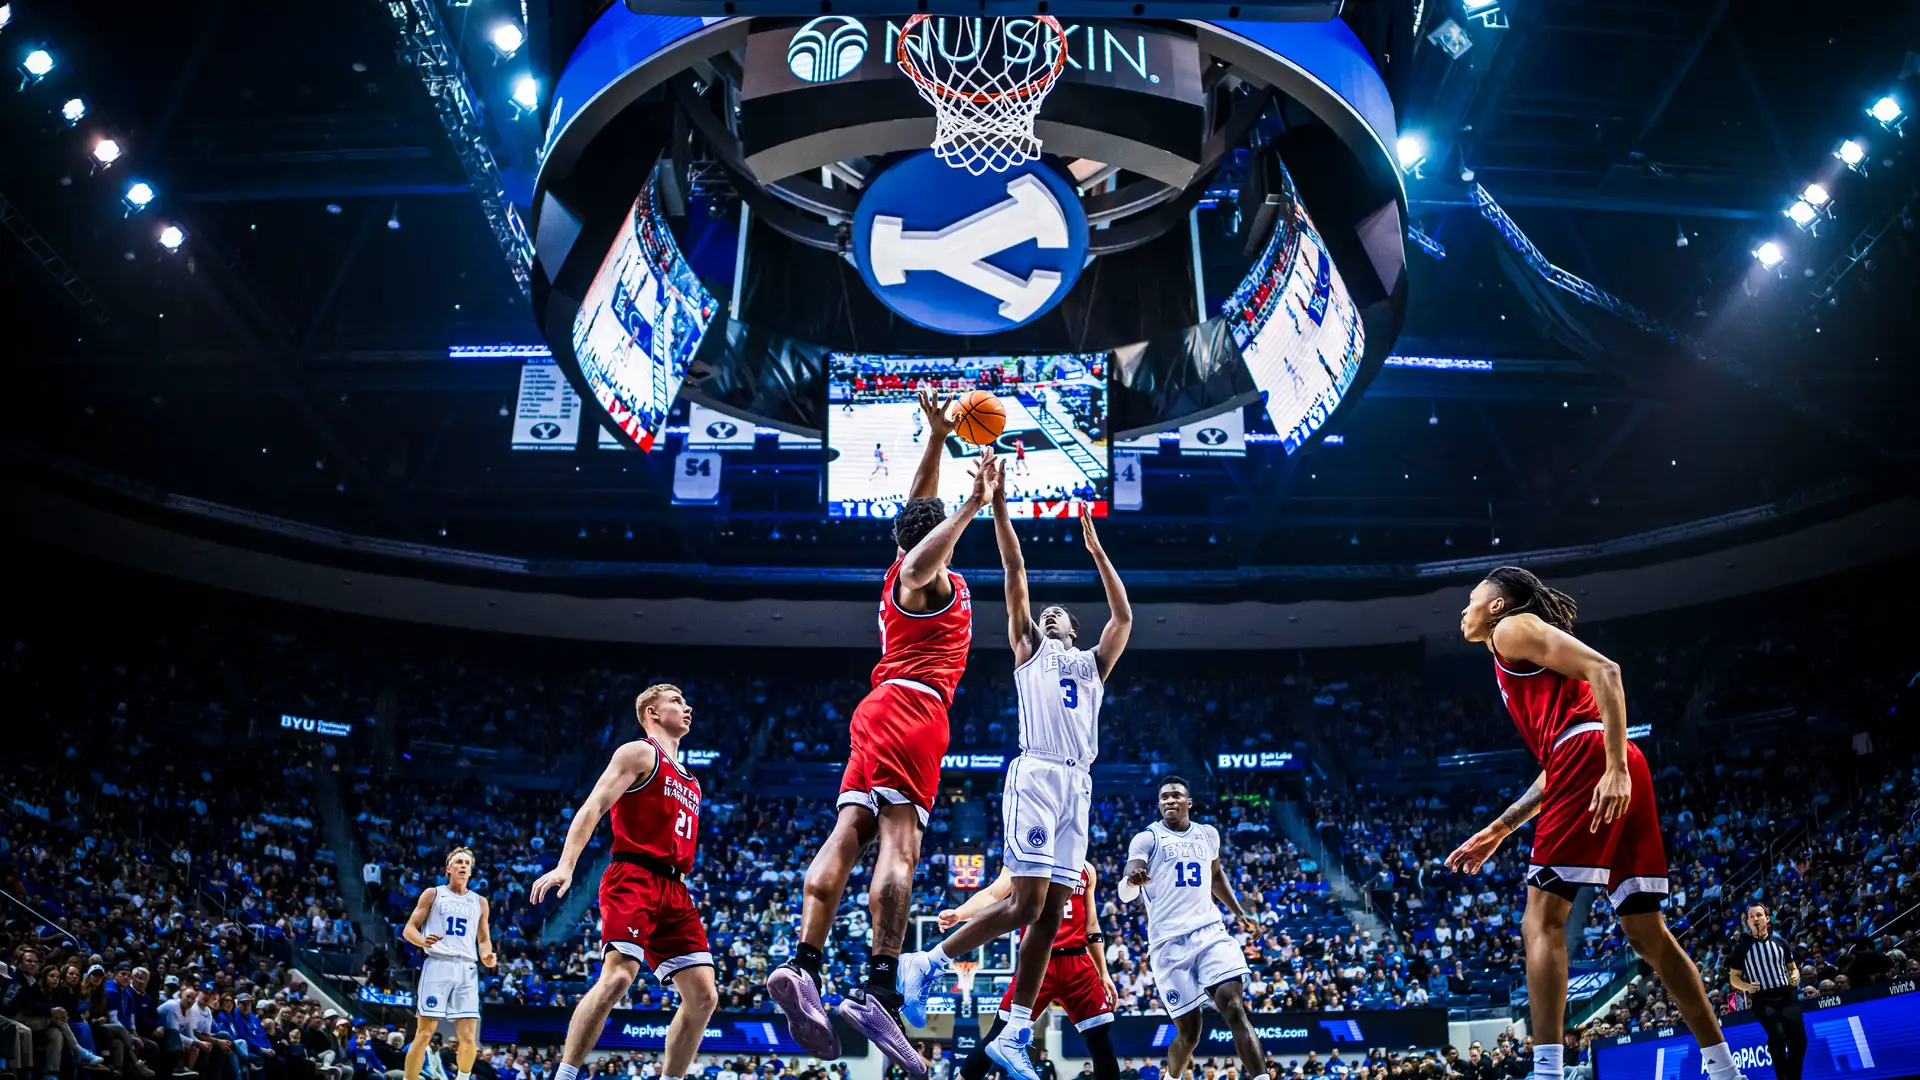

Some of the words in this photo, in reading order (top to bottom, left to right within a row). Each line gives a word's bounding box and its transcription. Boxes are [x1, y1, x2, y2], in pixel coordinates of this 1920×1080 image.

[884, 16, 982, 64] NU
[870, 173, 1069, 323] Y
[685, 458, 710, 476] 54
[1046, 652, 1092, 682] BYU
[1059, 678, 1078, 709] 3
[281, 714, 315, 732] BYU
[688, 759, 711, 767] Center
[1218, 754, 1257, 768] BYU
[1276, 752, 1292, 760] Lake
[1261, 760, 1284, 768] Center
[664, 785, 700, 816] WASHINGTO
[665, 775, 700, 806] EASTERN
[675, 808, 693, 840] 21
[1163, 842, 1207, 862] BYU
[954, 868, 979, 888] 25
[1175, 862, 1202, 887] 13
[446, 916, 467, 937] 15
